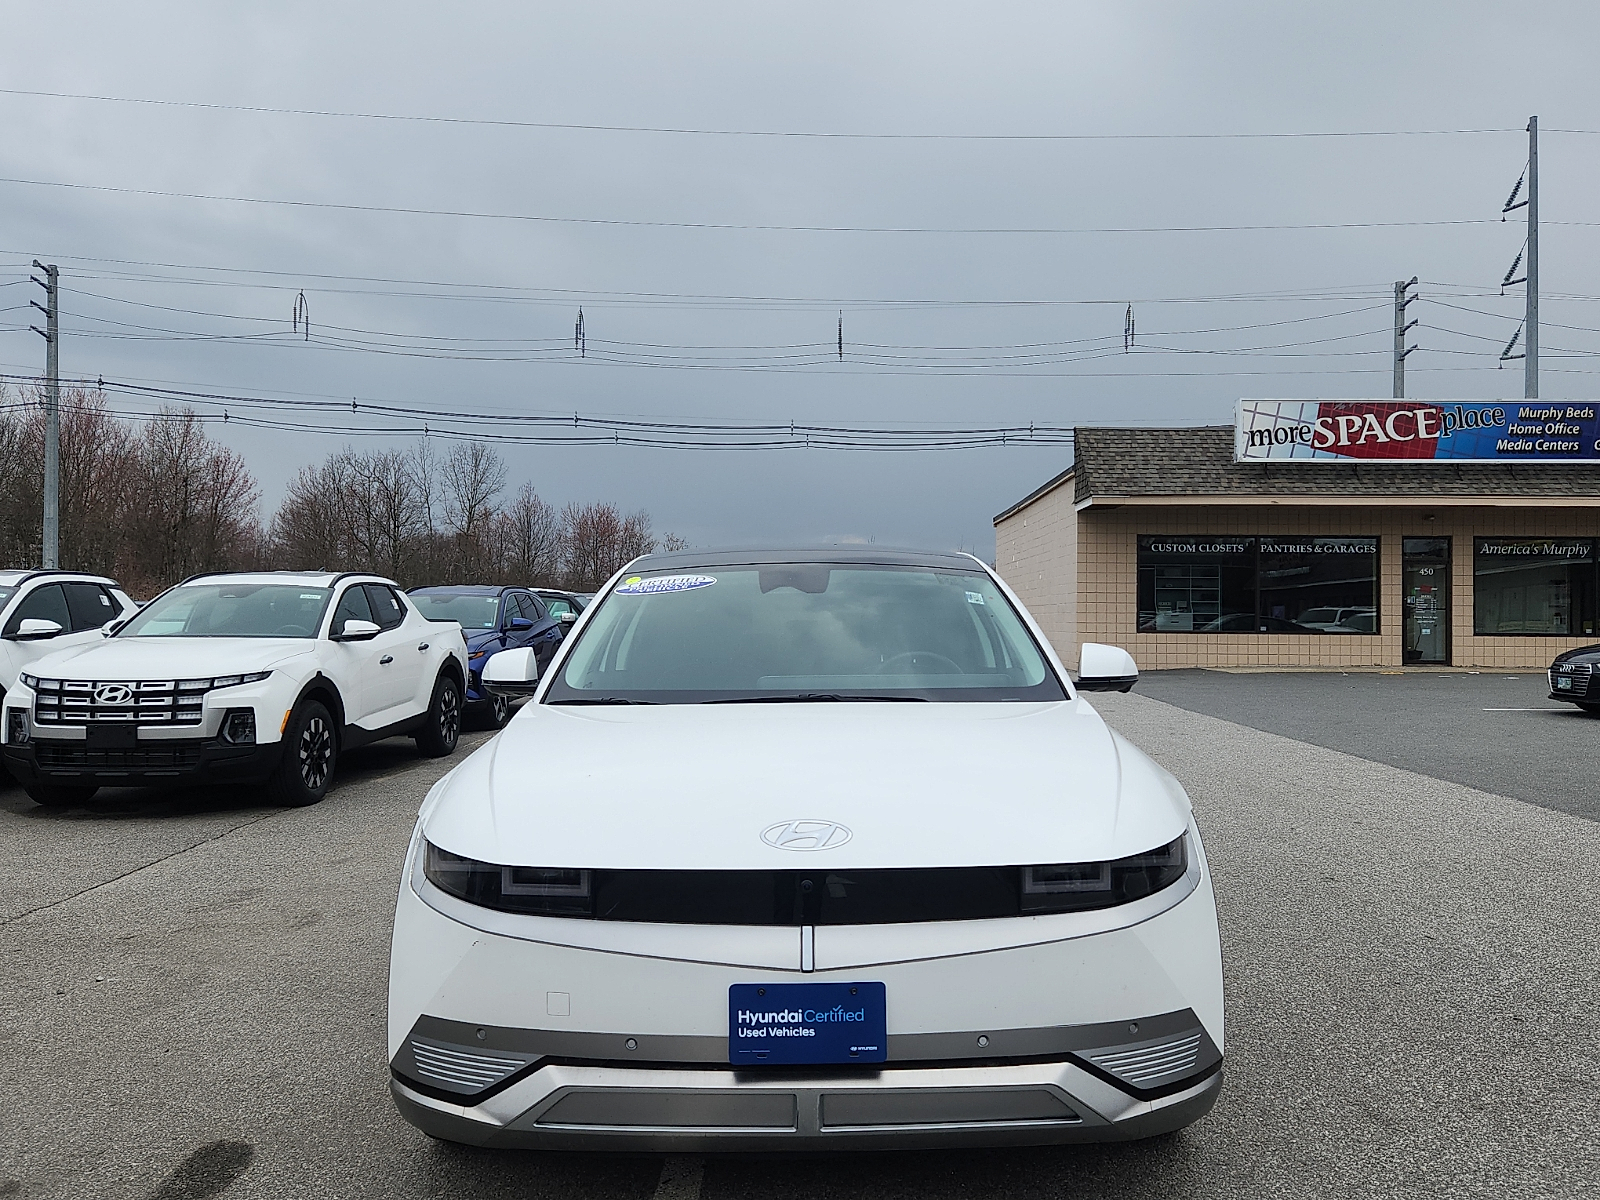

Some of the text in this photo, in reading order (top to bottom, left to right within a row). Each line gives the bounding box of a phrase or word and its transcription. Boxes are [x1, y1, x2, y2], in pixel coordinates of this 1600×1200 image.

[1518, 406, 1594, 421] Murphy Beds
[1507, 422, 1580, 434] Home Office
[1495, 438, 1533, 450] Media
[1535, 439, 1580, 451] Centers
[1151, 542, 1244, 553] CUSTOM CLOSETS
[1260, 543, 1377, 554] PANTRIES & GARAGES
[1480, 543, 1591, 558] America's Murphy
[1419, 567, 1434, 576] 450
[738, 1005, 865, 1026] Hyundai Certified
[738, 1026, 816, 1037] Used Vehicles
